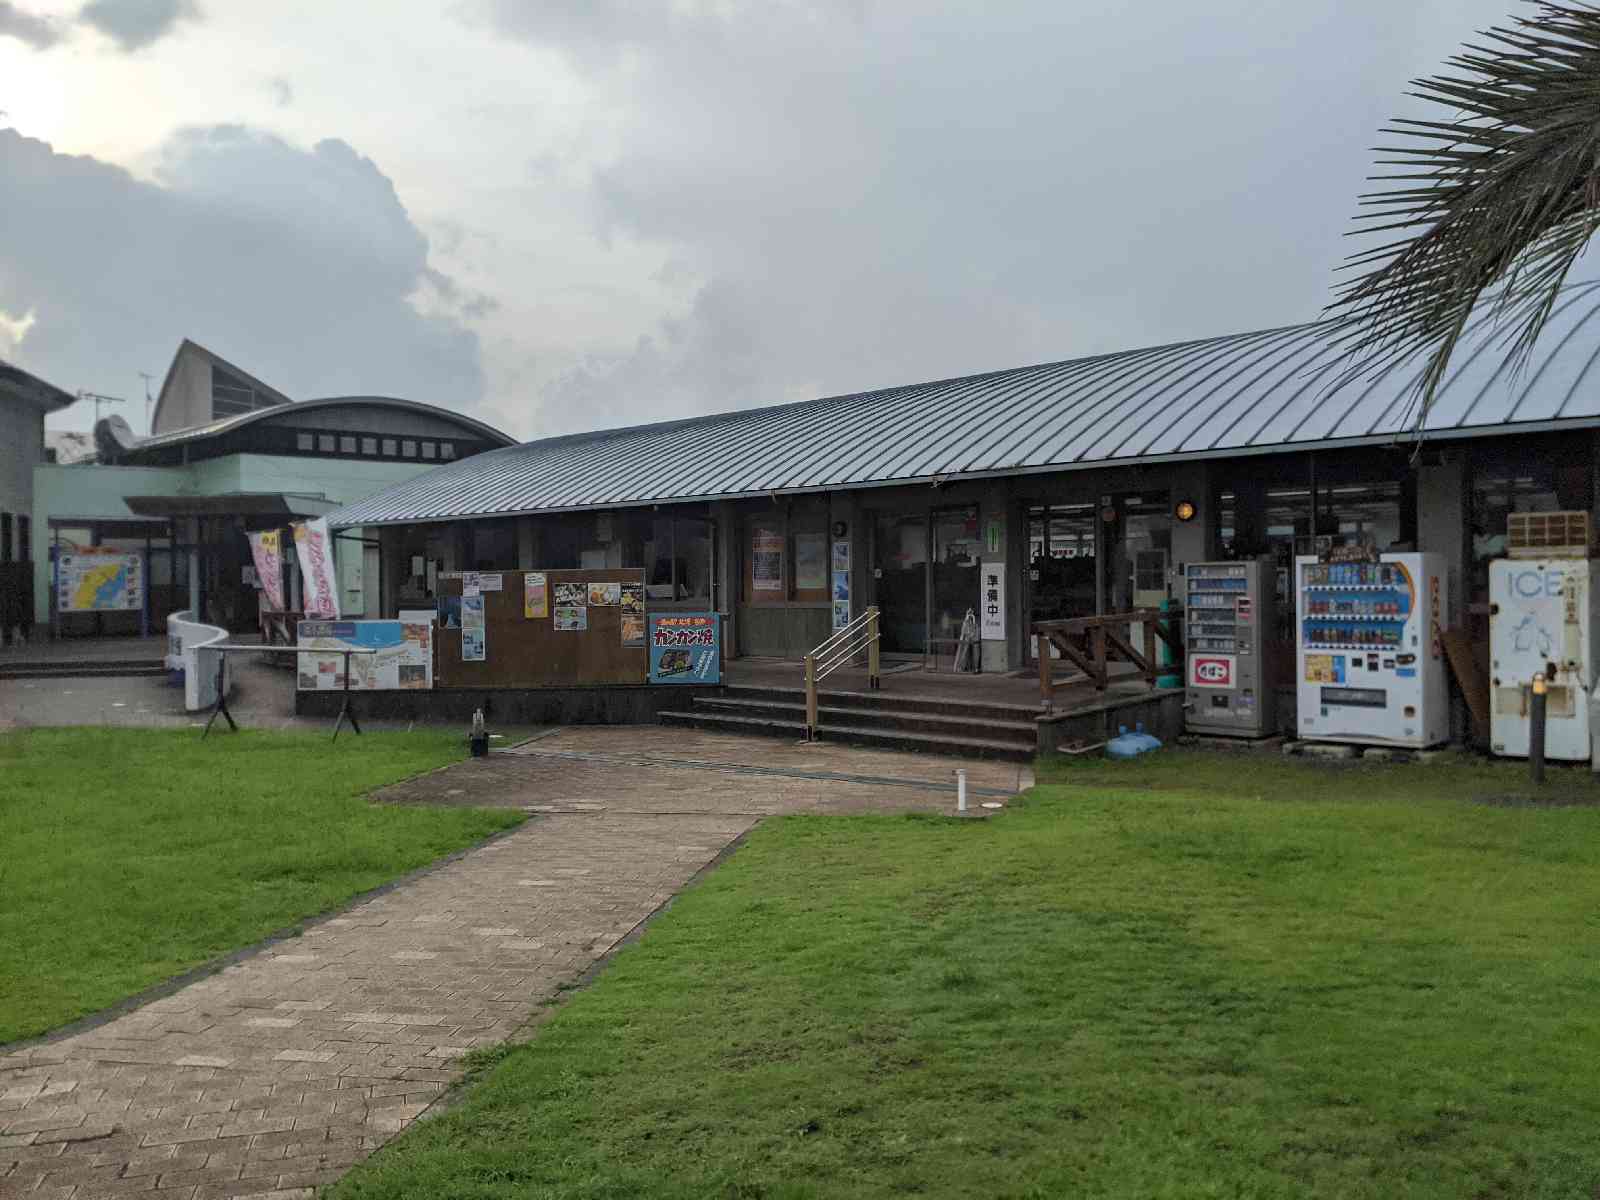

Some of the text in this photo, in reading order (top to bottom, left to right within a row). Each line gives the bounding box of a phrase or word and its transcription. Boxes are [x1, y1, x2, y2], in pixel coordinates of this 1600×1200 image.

[1507, 571, 1564, 597] ICE
[1201, 664, 1224, 678] たばこ
